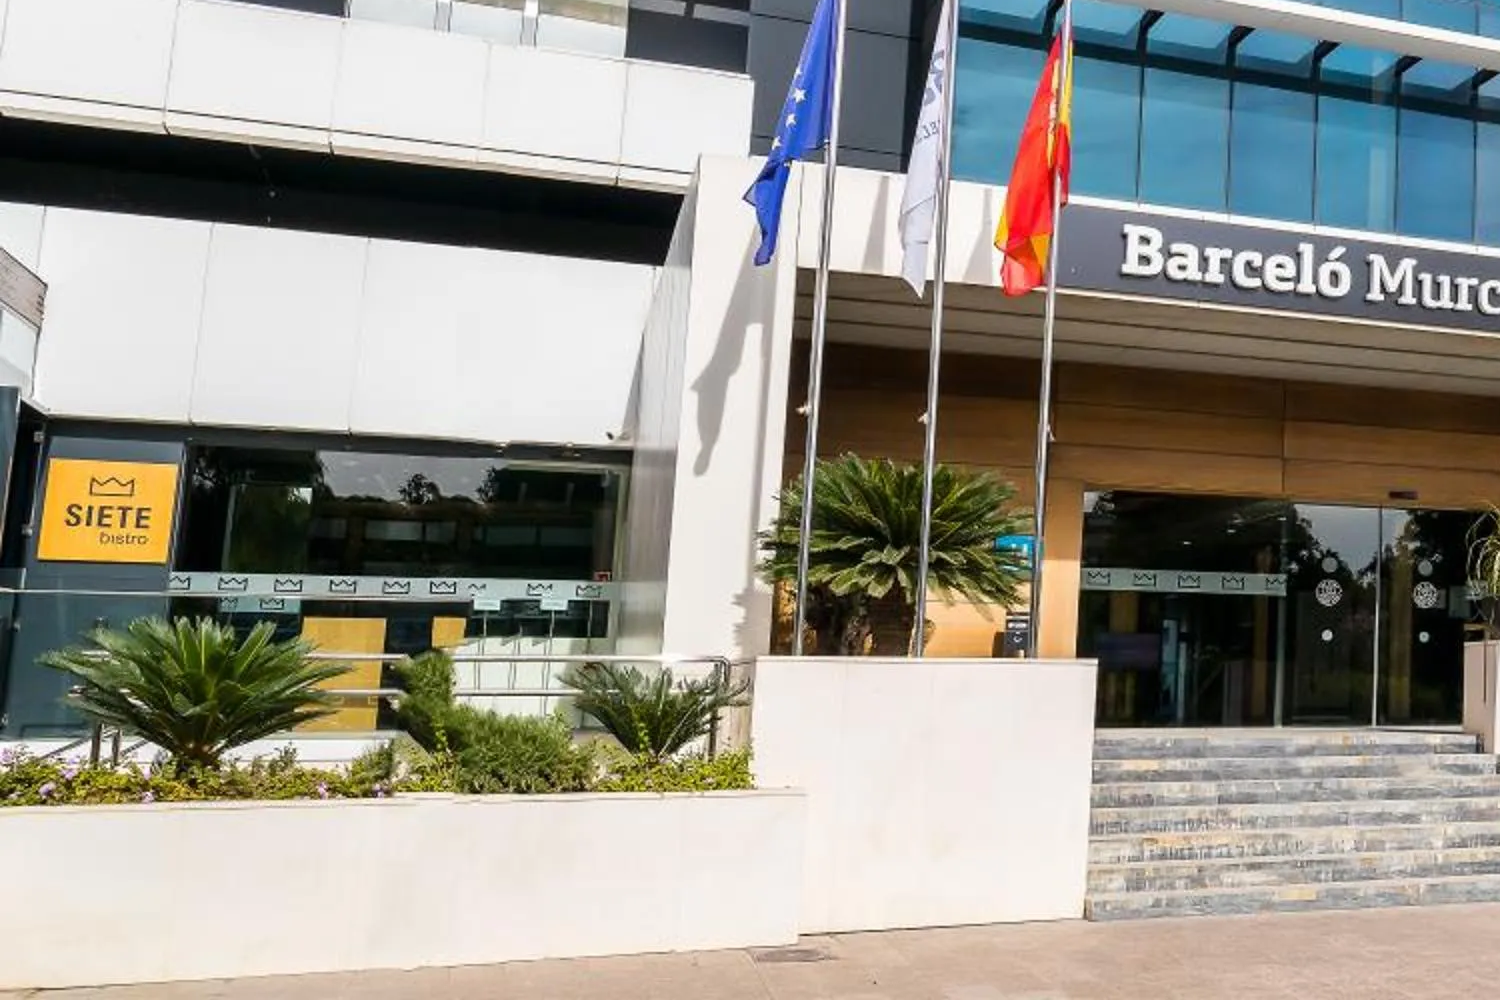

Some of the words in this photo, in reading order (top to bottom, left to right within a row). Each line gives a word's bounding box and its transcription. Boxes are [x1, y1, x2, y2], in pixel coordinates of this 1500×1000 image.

[1121, 223, 1352, 299] Barceló
[64, 503, 152, 529] SIETE
[99, 531, 149, 545] bistro
